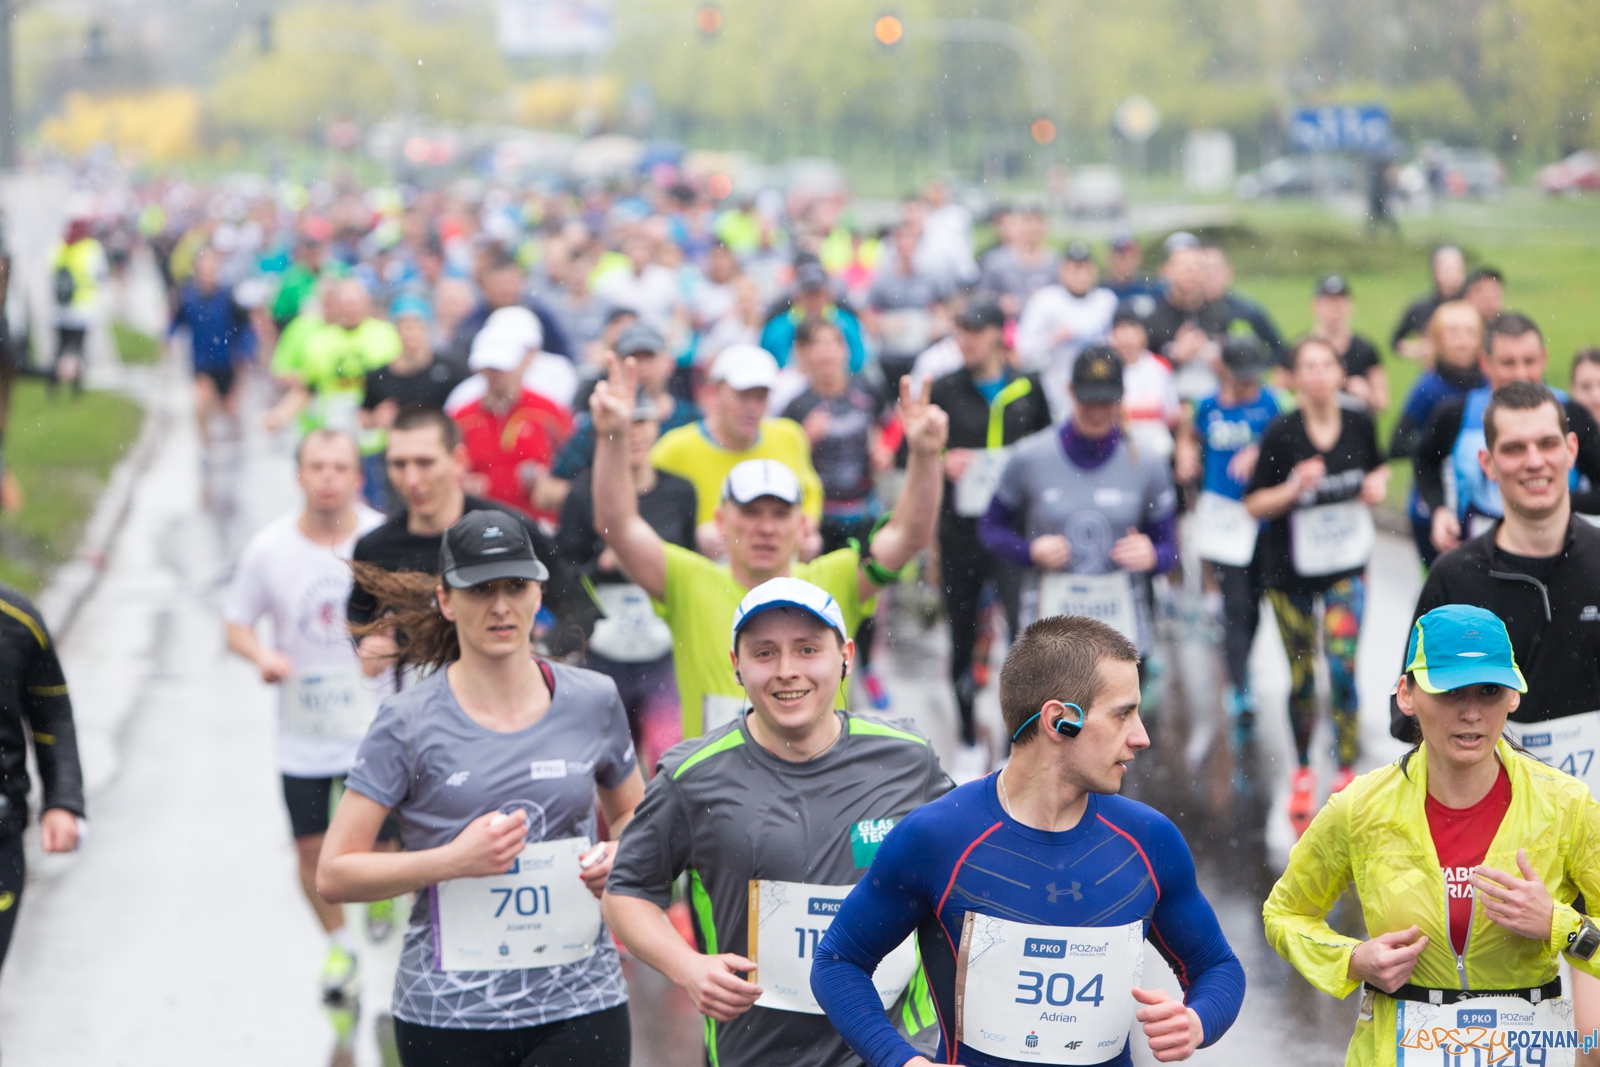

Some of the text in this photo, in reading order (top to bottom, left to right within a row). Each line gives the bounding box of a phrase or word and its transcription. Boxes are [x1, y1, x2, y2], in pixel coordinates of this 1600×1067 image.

[1540, 749, 1594, 777] 47
[858, 819, 893, 831] GLAS
[490, 886, 550, 918] 701
[506, 922, 542, 931] Joanna
[795, 927, 827, 959] 11
[1040, 945, 1060, 954] PKO
[1015, 970, 1104, 1007] 304
[1040, 1011, 1076, 1022] Adrian
[1472, 1014, 1491, 1024] PKO
[983, 1031, 1007, 1042] posir
[1064, 1041, 1083, 1050] 4F
